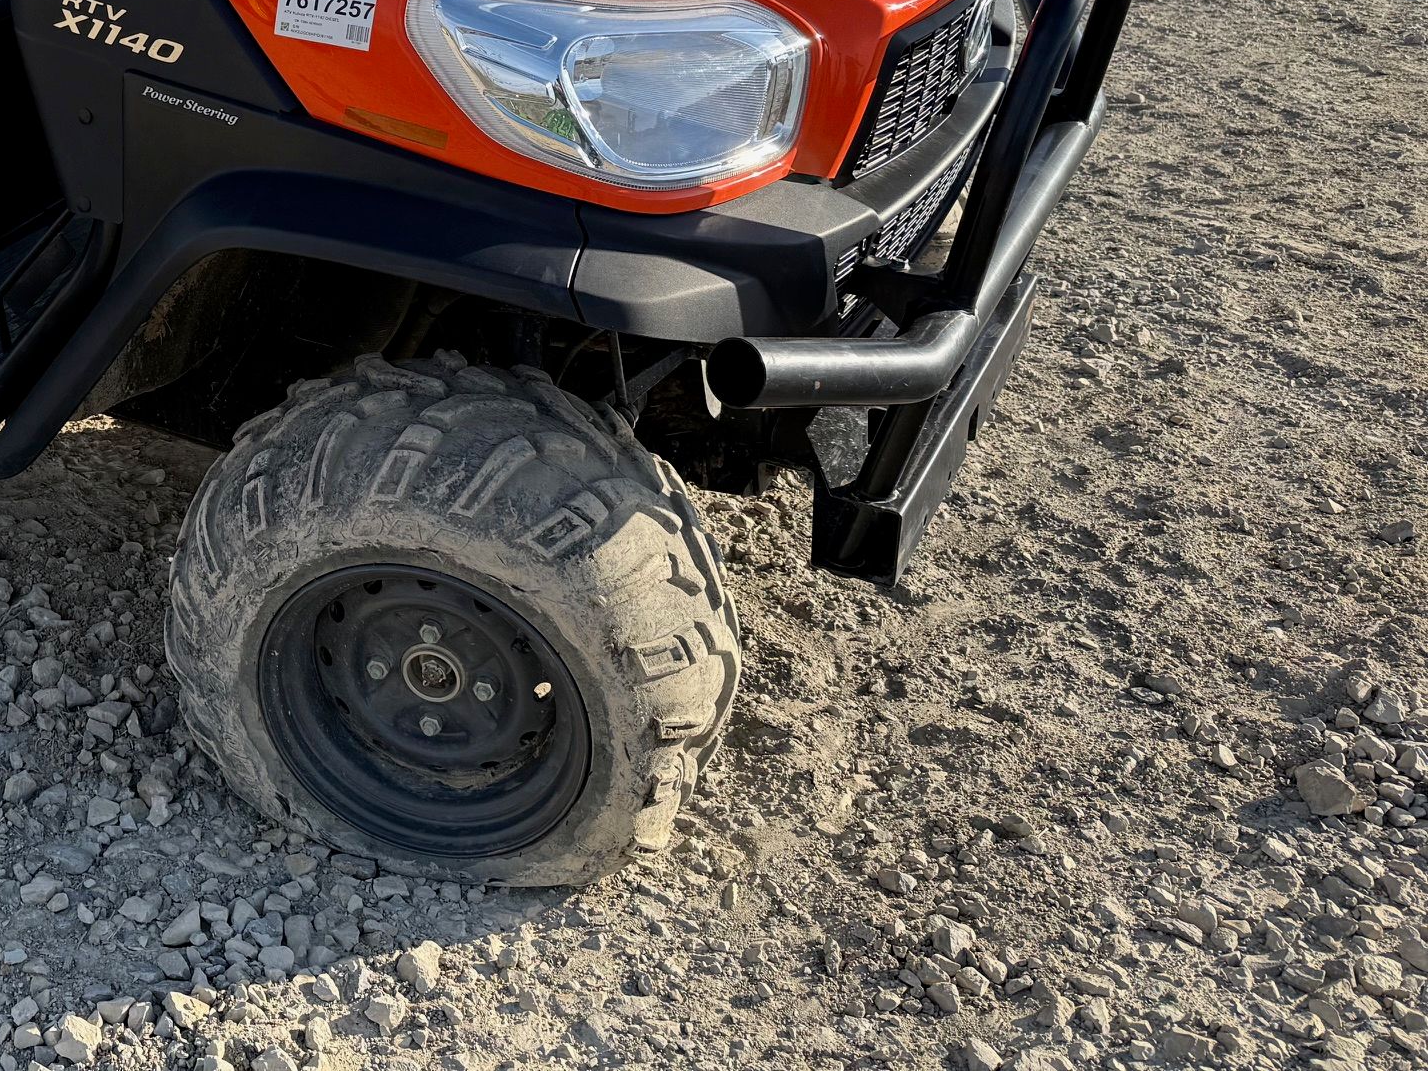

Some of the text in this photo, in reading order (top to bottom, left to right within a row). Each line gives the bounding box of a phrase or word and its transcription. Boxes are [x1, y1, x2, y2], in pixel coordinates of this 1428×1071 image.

[53, 8, 184, 64] X1140
[142, 86, 239, 126] Power Steering
